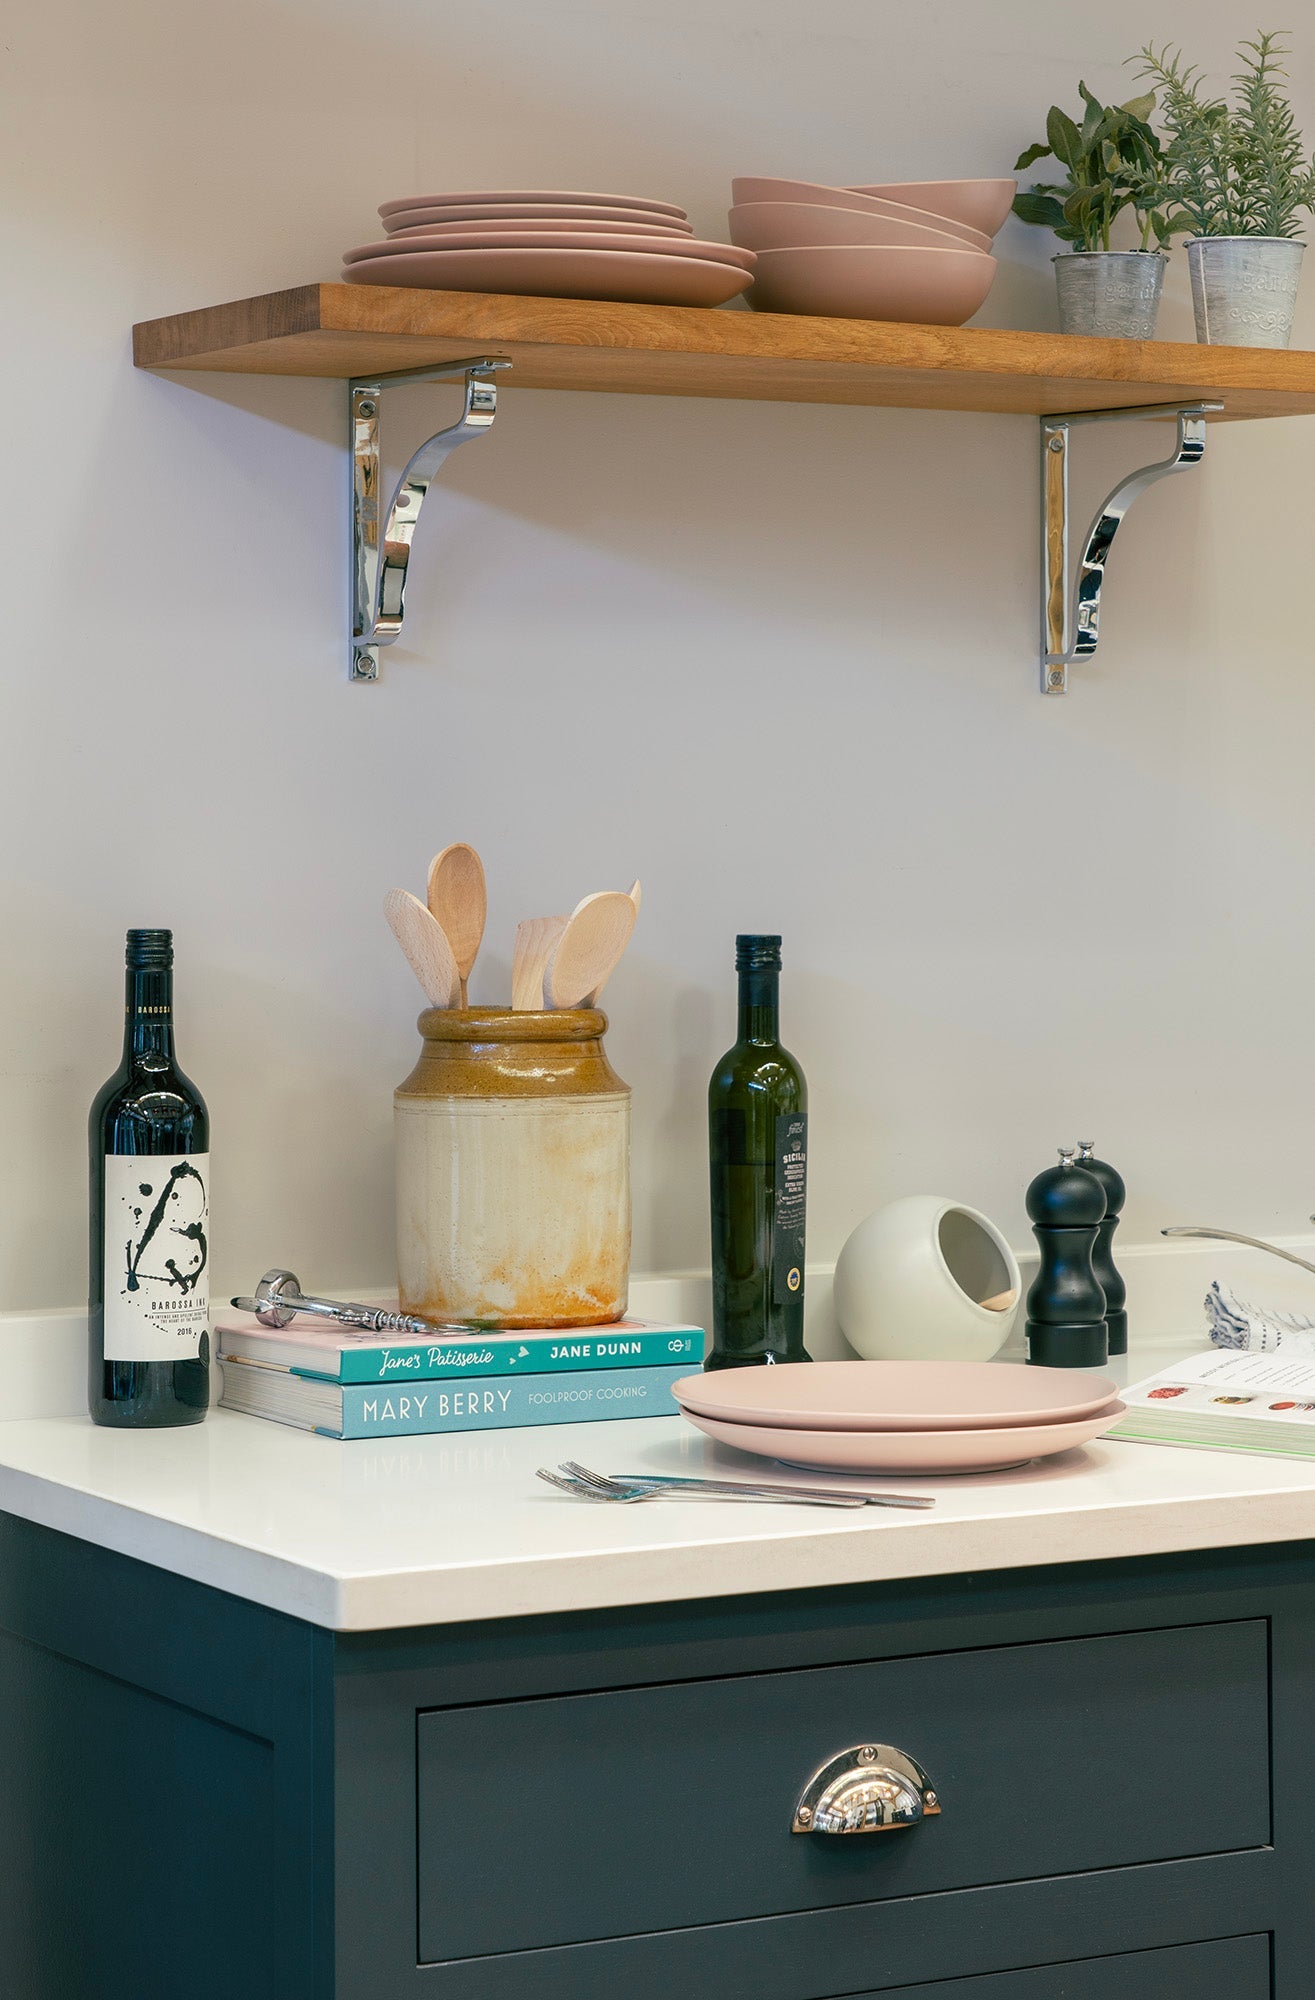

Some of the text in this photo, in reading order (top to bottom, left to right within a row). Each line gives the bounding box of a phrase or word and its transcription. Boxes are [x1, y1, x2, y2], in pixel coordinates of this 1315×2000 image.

[151, 1300, 193, 1310] BAROSSA
[177, 1327, 192, 1336] 2016
[550, 1341, 642, 1359] JANE DUNN
[378, 1347, 495, 1377] Jane's Patisserie
[528, 1385, 648, 1405] FOOLPROOF COOKING
[362, 1390, 513, 1422] MARY BERRY
